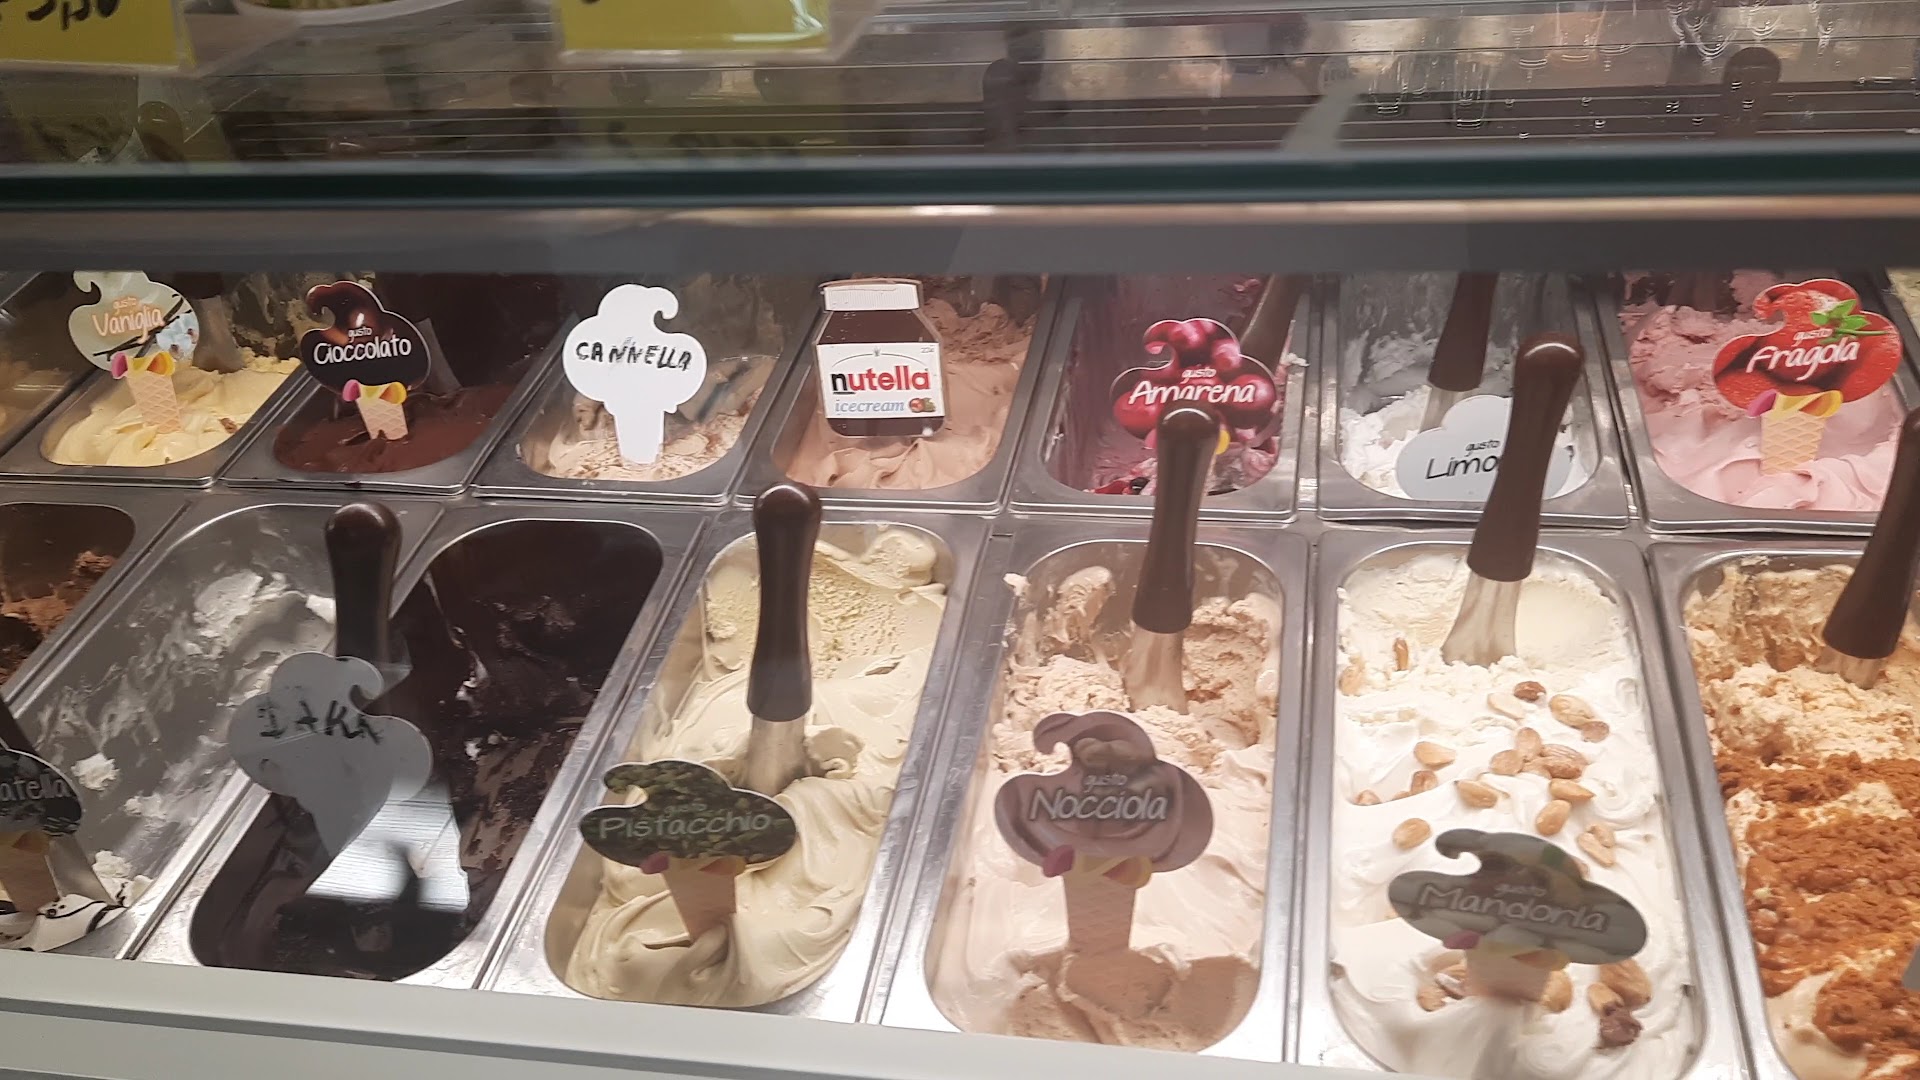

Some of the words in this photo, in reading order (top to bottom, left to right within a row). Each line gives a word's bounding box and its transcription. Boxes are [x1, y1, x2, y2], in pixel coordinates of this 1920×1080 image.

[91, 305, 165, 345] Vaniglia
[348, 326, 373, 343] gusto
[1794, 328, 1833, 347] gusto
[313, 334, 412, 365] Cioccolato
[575, 337, 692, 372] CANNELLA
[831, 365, 931, 392] nutella
[1180, 366, 1217, 385] gusto
[1127, 380, 1256, 405] Amarena
[834, 399, 905, 413] icecream
[1464, 440, 1501, 458] gusto
[1425, 455, 1500, 479] Limo
[1083, 772, 1128, 794] gusto
[1028, 788, 1169, 821] Nocciola
[600, 812, 771, 839] Pistacchio
[1418, 883, 1608, 932] Mandorla
